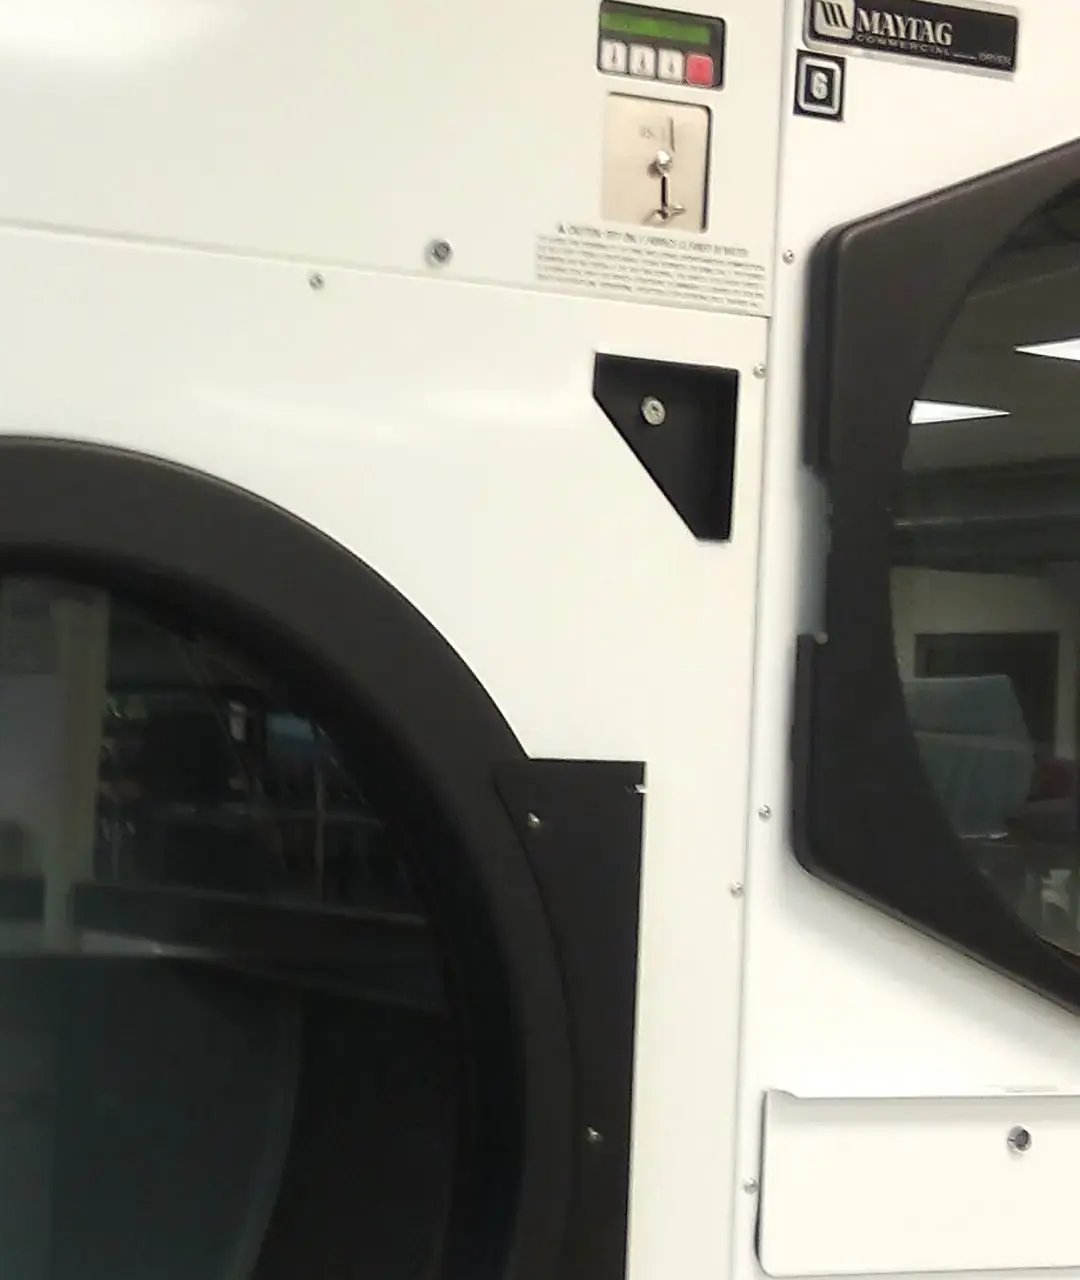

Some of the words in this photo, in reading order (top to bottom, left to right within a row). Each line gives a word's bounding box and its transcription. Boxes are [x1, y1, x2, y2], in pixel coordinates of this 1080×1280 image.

[857, 6, 952, 46] MAYTAG
[856, 33, 951, 57] COMMERCIAL
[810, 71, 828, 100] 6
